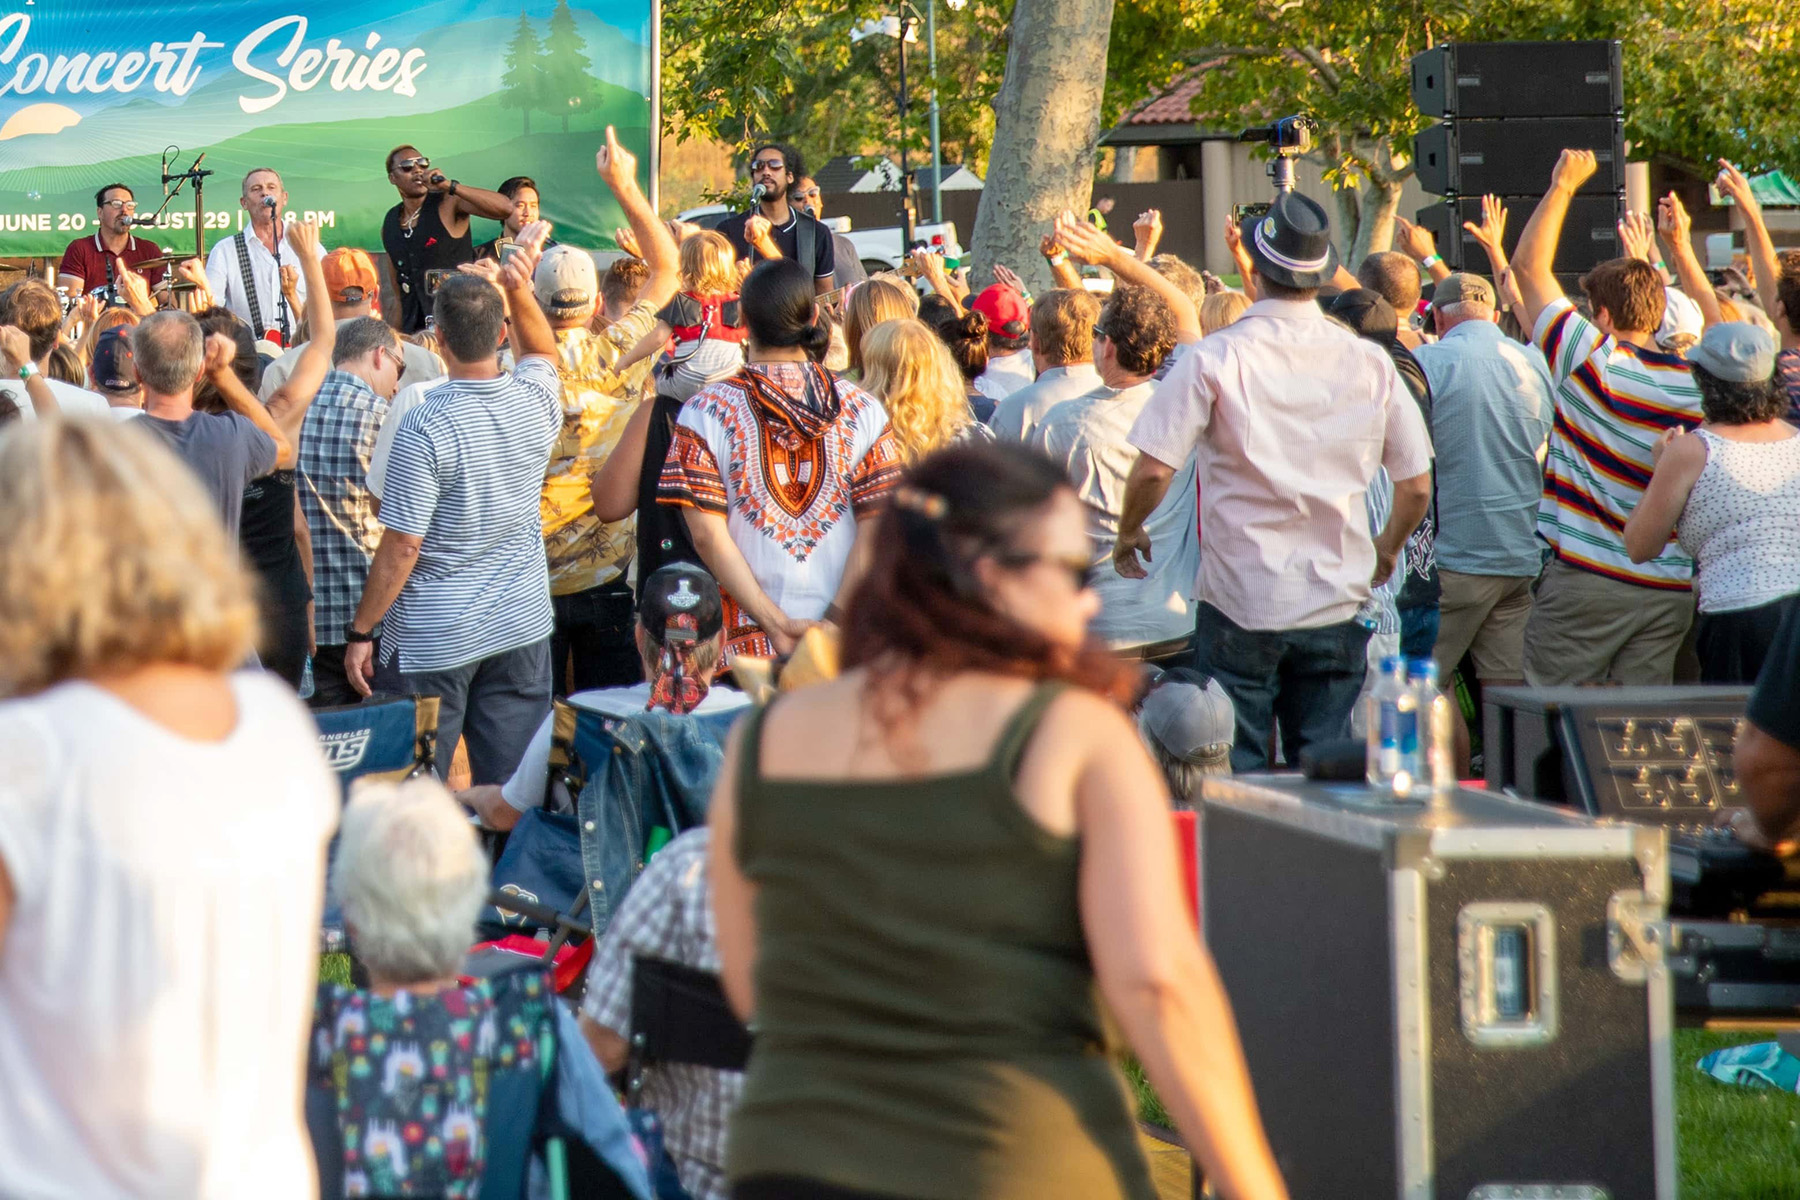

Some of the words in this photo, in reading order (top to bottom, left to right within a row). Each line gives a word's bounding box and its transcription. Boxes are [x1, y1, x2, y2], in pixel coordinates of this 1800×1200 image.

[232, 15, 428, 114] Series
[57, 213, 86, 231] 20
[203, 211, 230, 229] 29
[303, 210, 335, 228] PM
[319, 728, 371, 741] ANGELES
